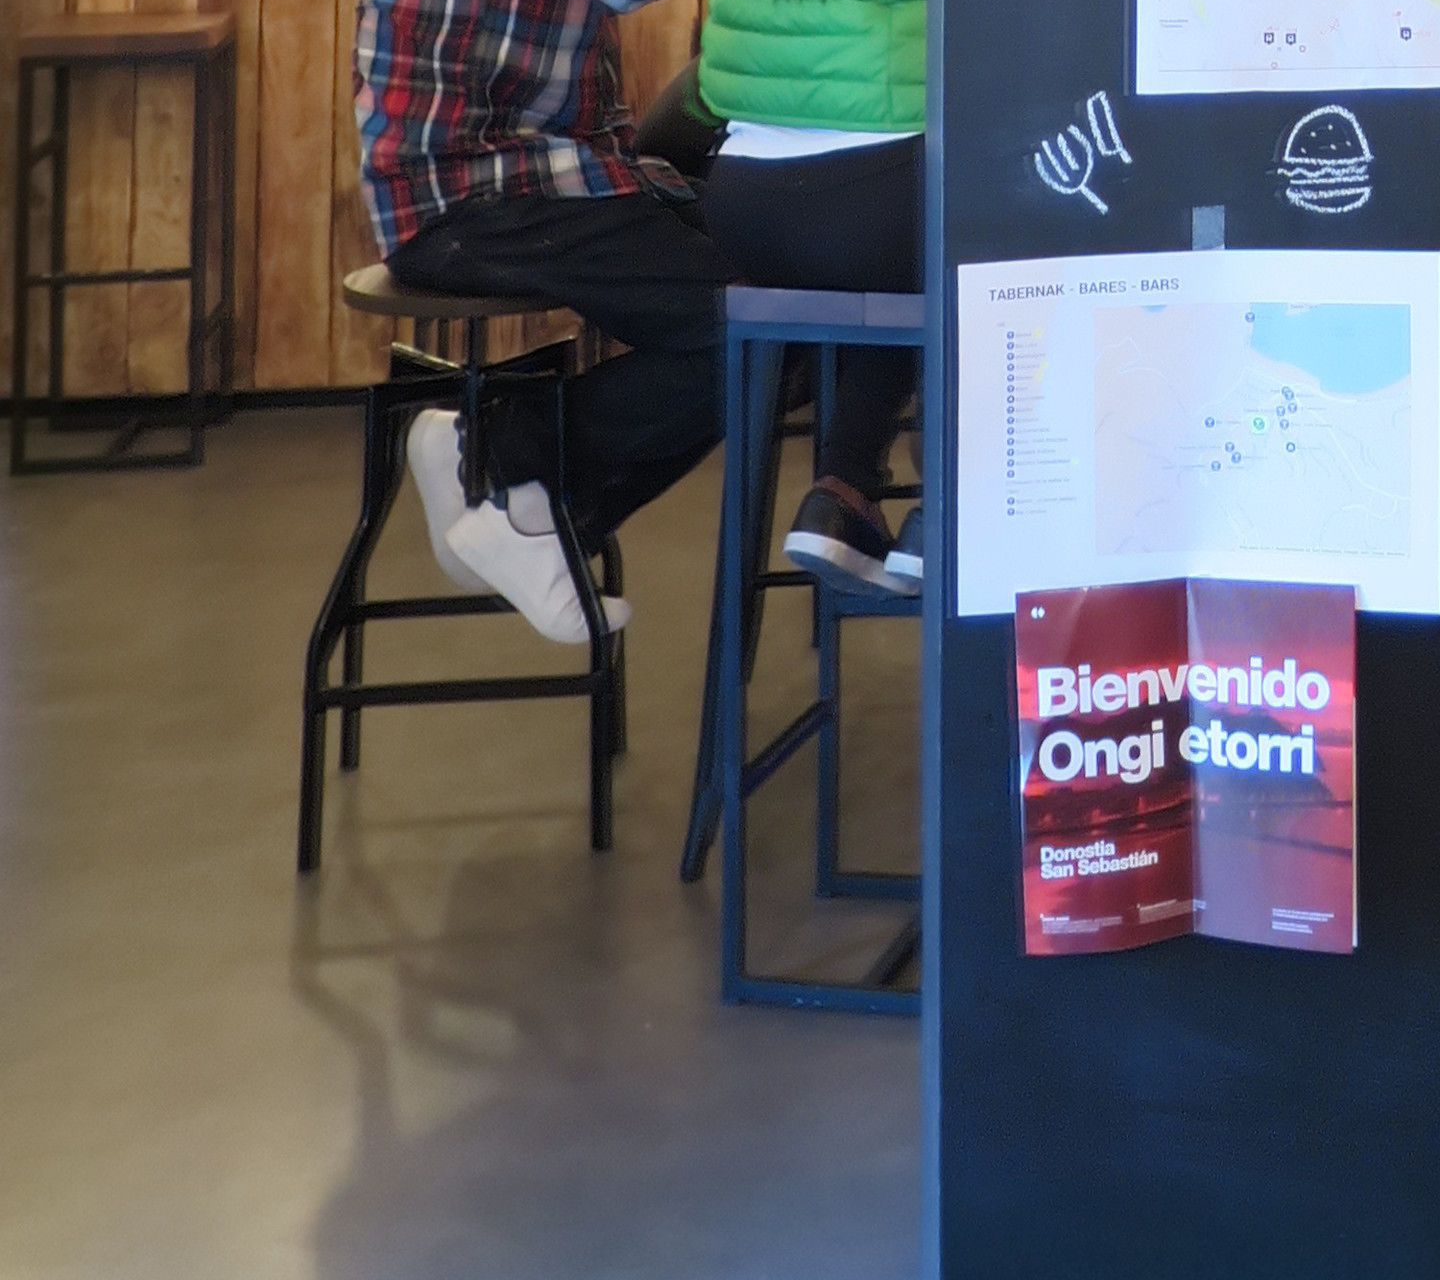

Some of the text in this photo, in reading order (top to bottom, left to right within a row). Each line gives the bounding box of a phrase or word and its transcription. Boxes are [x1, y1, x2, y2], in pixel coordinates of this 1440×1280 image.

[988, 283, 1065, 302] TABERNAK
[1079, 280, 1127, 295] BARES
[1140, 277, 1180, 292] BARS
[1036, 656, 1331, 718] Bienvenido
[1038, 719, 1314, 784] Ongi etorri
[1040, 840, 1116, 864] Donostia
[1040, 850, 1159, 880] San Sebastián
